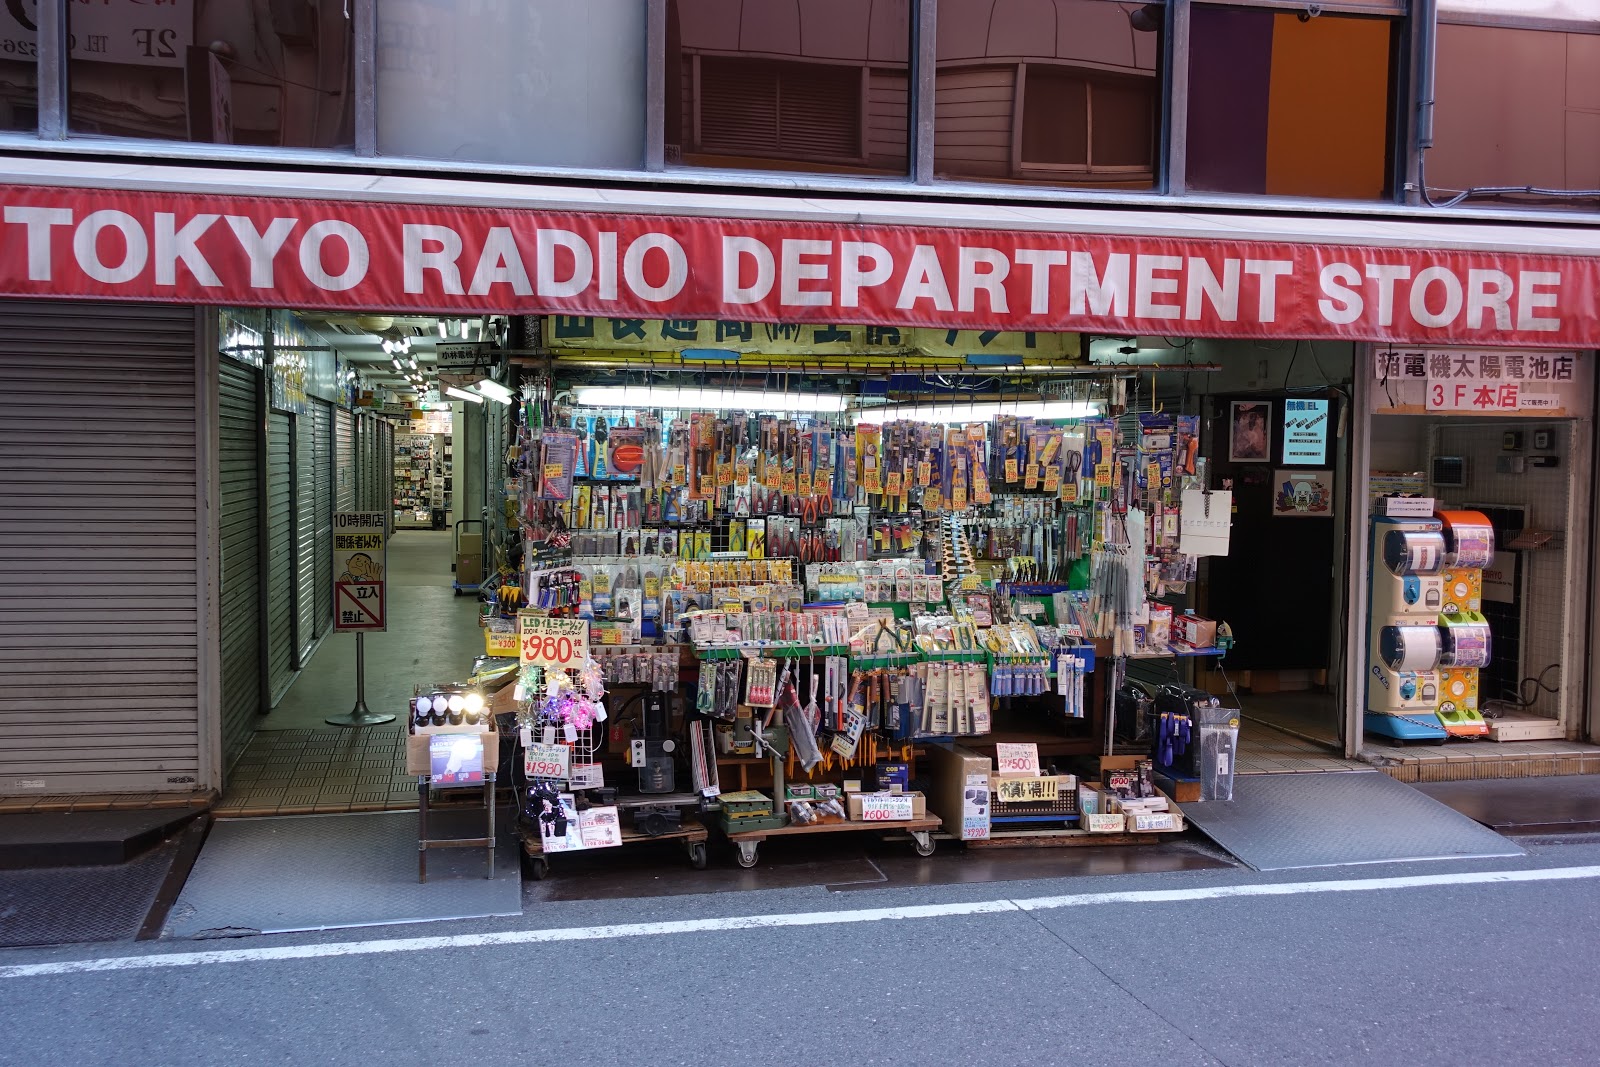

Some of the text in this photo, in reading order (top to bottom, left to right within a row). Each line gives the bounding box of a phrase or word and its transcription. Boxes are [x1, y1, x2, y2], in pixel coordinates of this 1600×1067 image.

[4, 206, 1561, 332] TOKYO RADIO DEPARTMENT STORE
[1378, 351, 1573, 381] 稲電機太陽電池店
[333, 513, 384, 528] 10時開店
[335, 535, 382, 549] 関係者以外
[356, 586, 379, 599] 立入
[342, 610, 364, 623] 禁止
[522, 635, 573, 664] ¥980
